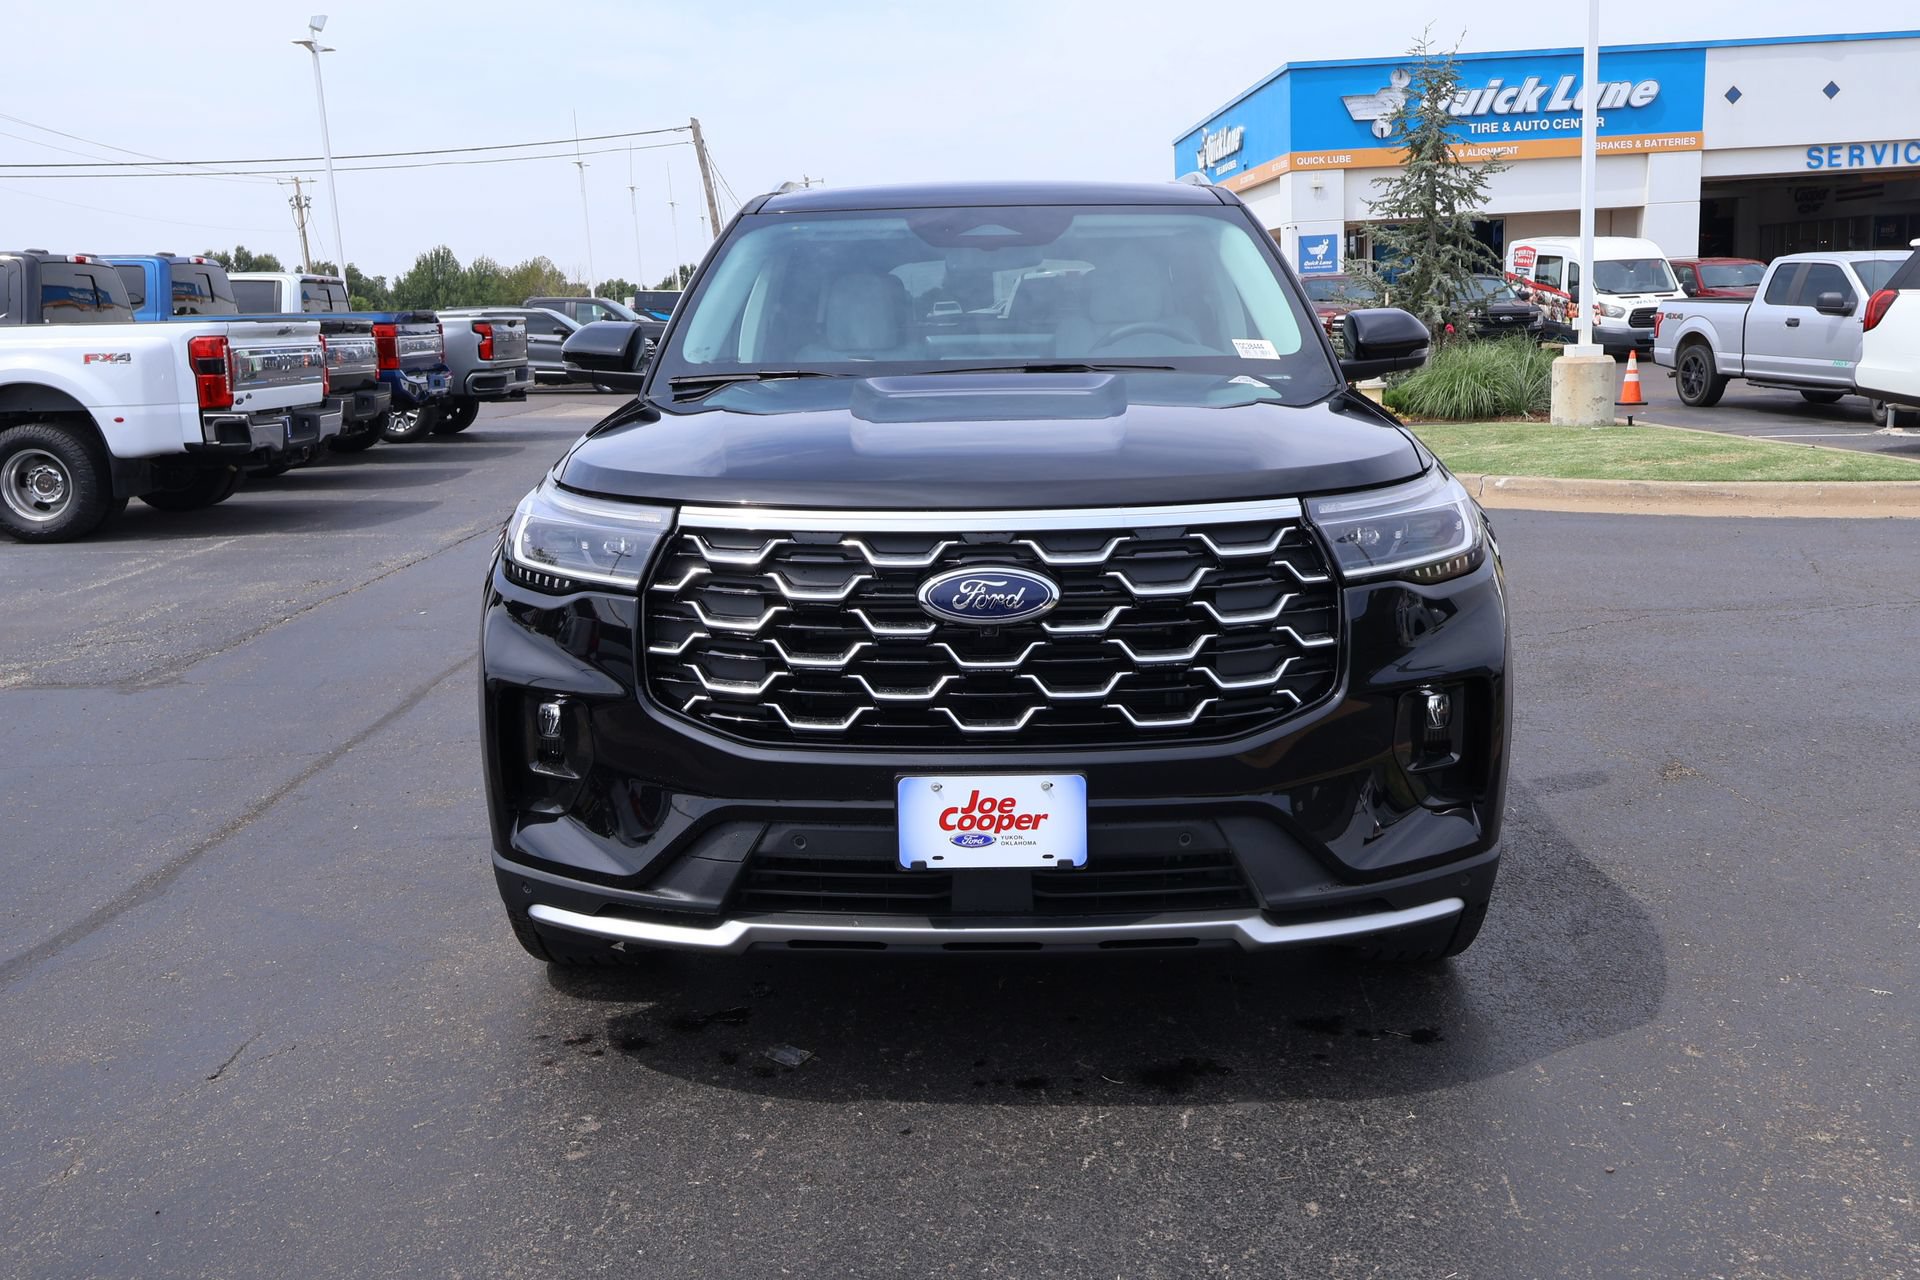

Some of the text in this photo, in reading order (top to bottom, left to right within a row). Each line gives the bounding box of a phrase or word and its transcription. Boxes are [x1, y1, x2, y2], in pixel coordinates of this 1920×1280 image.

[1469, 116, 1605, 134] TIRE & AUTO CENR
[1596, 136, 1696, 150] BRAKES & BATTERIES
[1296, 155, 1326, 166] QUICK
[1327, 154, 1351, 164] LUBE
[83, 352, 131, 364] FX4
[952, 579, 1026, 610] Ford
[961, 790, 1016, 814] Joe
[939, 807, 1048, 833] Cooper
